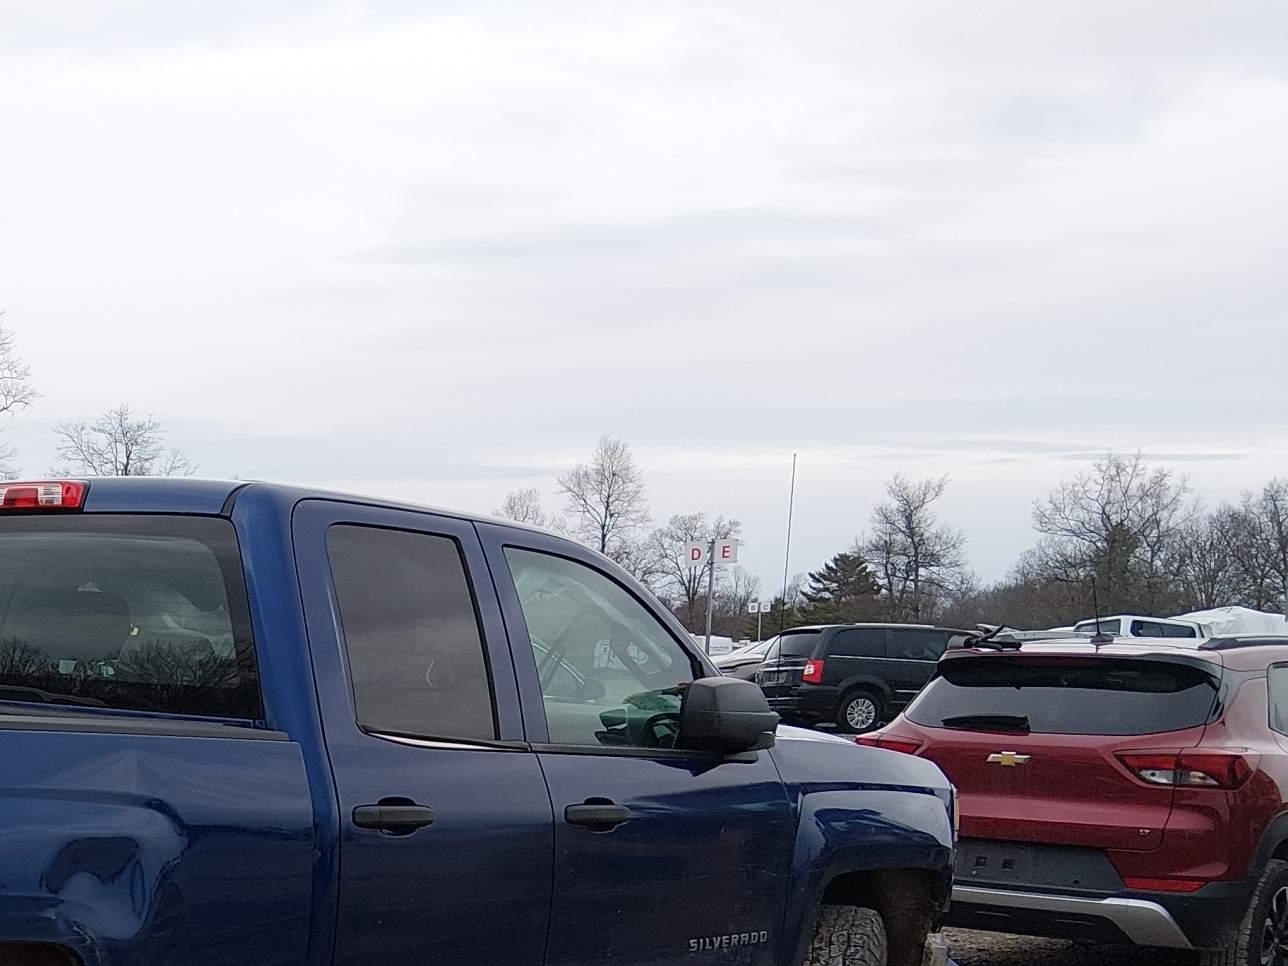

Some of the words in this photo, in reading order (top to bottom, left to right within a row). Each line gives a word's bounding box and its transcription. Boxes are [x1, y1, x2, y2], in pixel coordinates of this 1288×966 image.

[691, 547, 702, 561] D
[721, 545, 731, 559] E
[688, 930, 768, 952] SILVERADO
